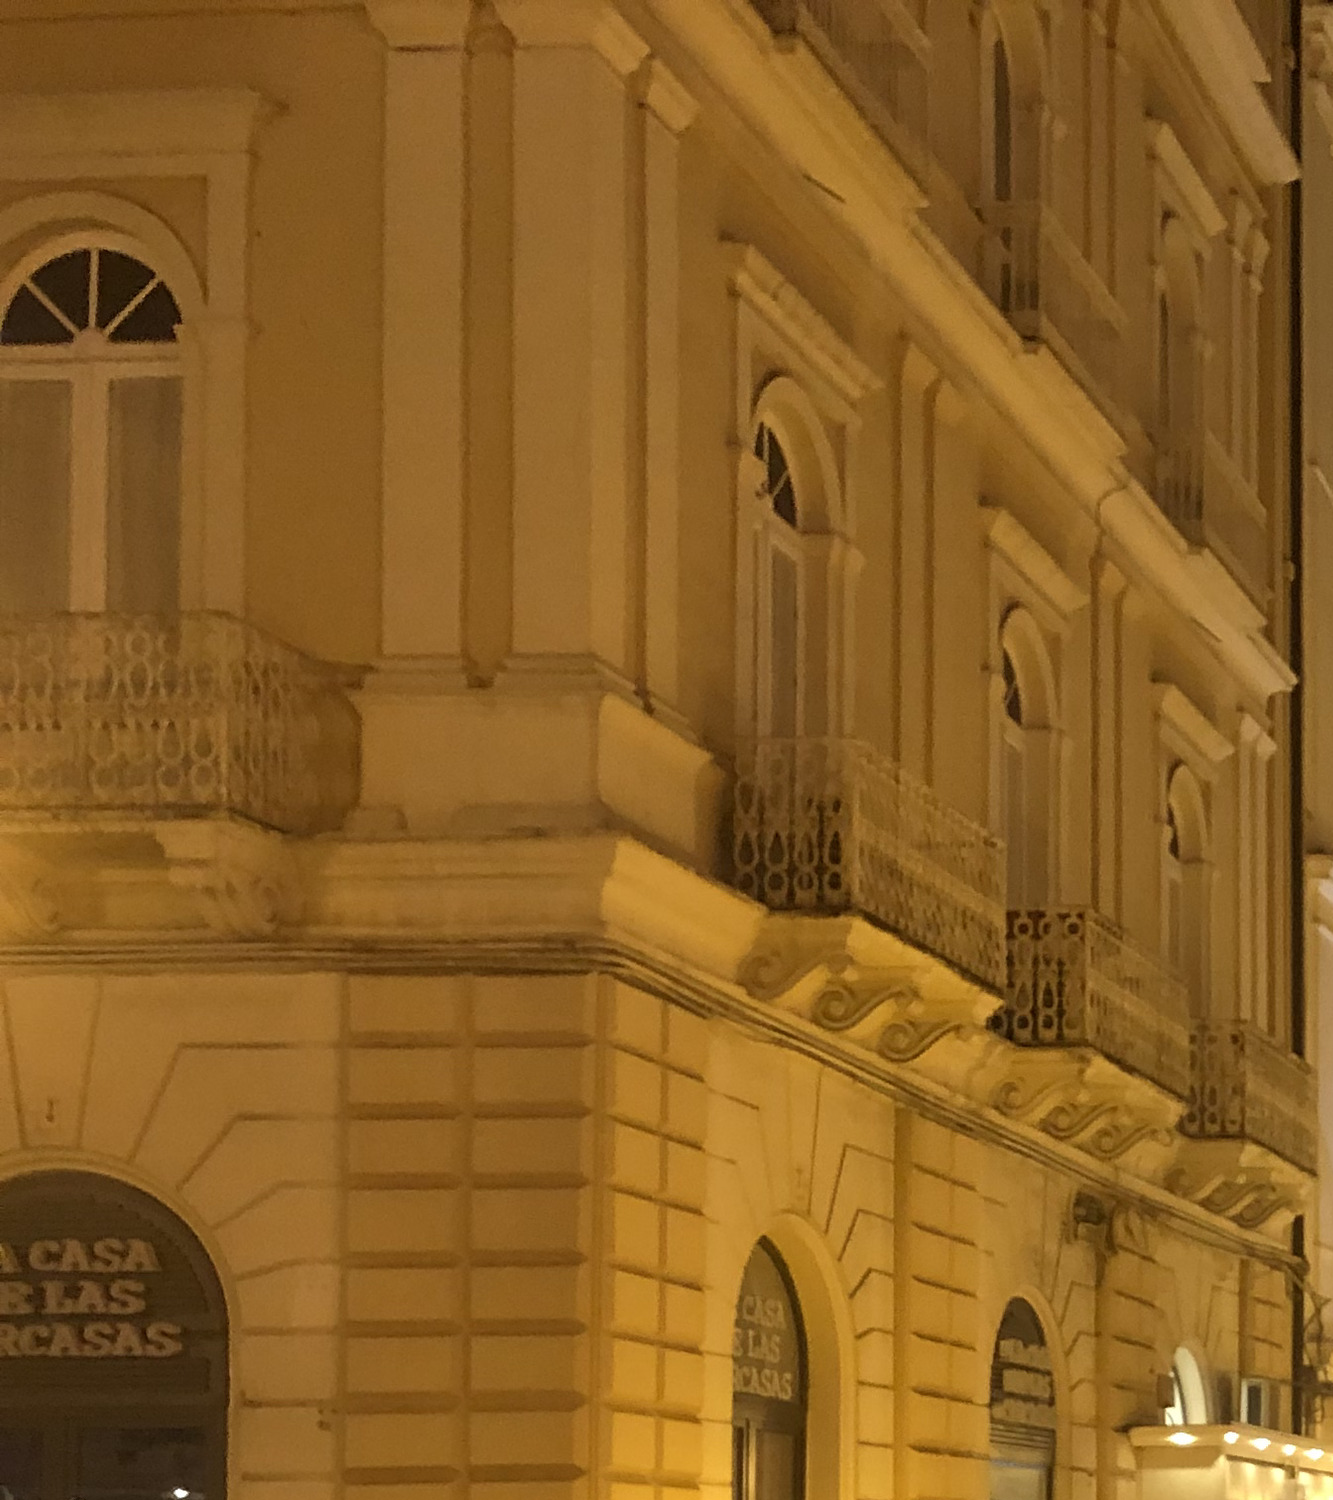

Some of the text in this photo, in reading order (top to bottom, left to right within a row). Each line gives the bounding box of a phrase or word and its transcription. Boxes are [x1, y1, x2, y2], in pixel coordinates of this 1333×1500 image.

[28, 1238, 162, 1272] CASA
[41, 1279, 146, 1314] LAS
[743, 1295, 787, 1330] CASA
[748, 1328, 781, 1363] LAS
